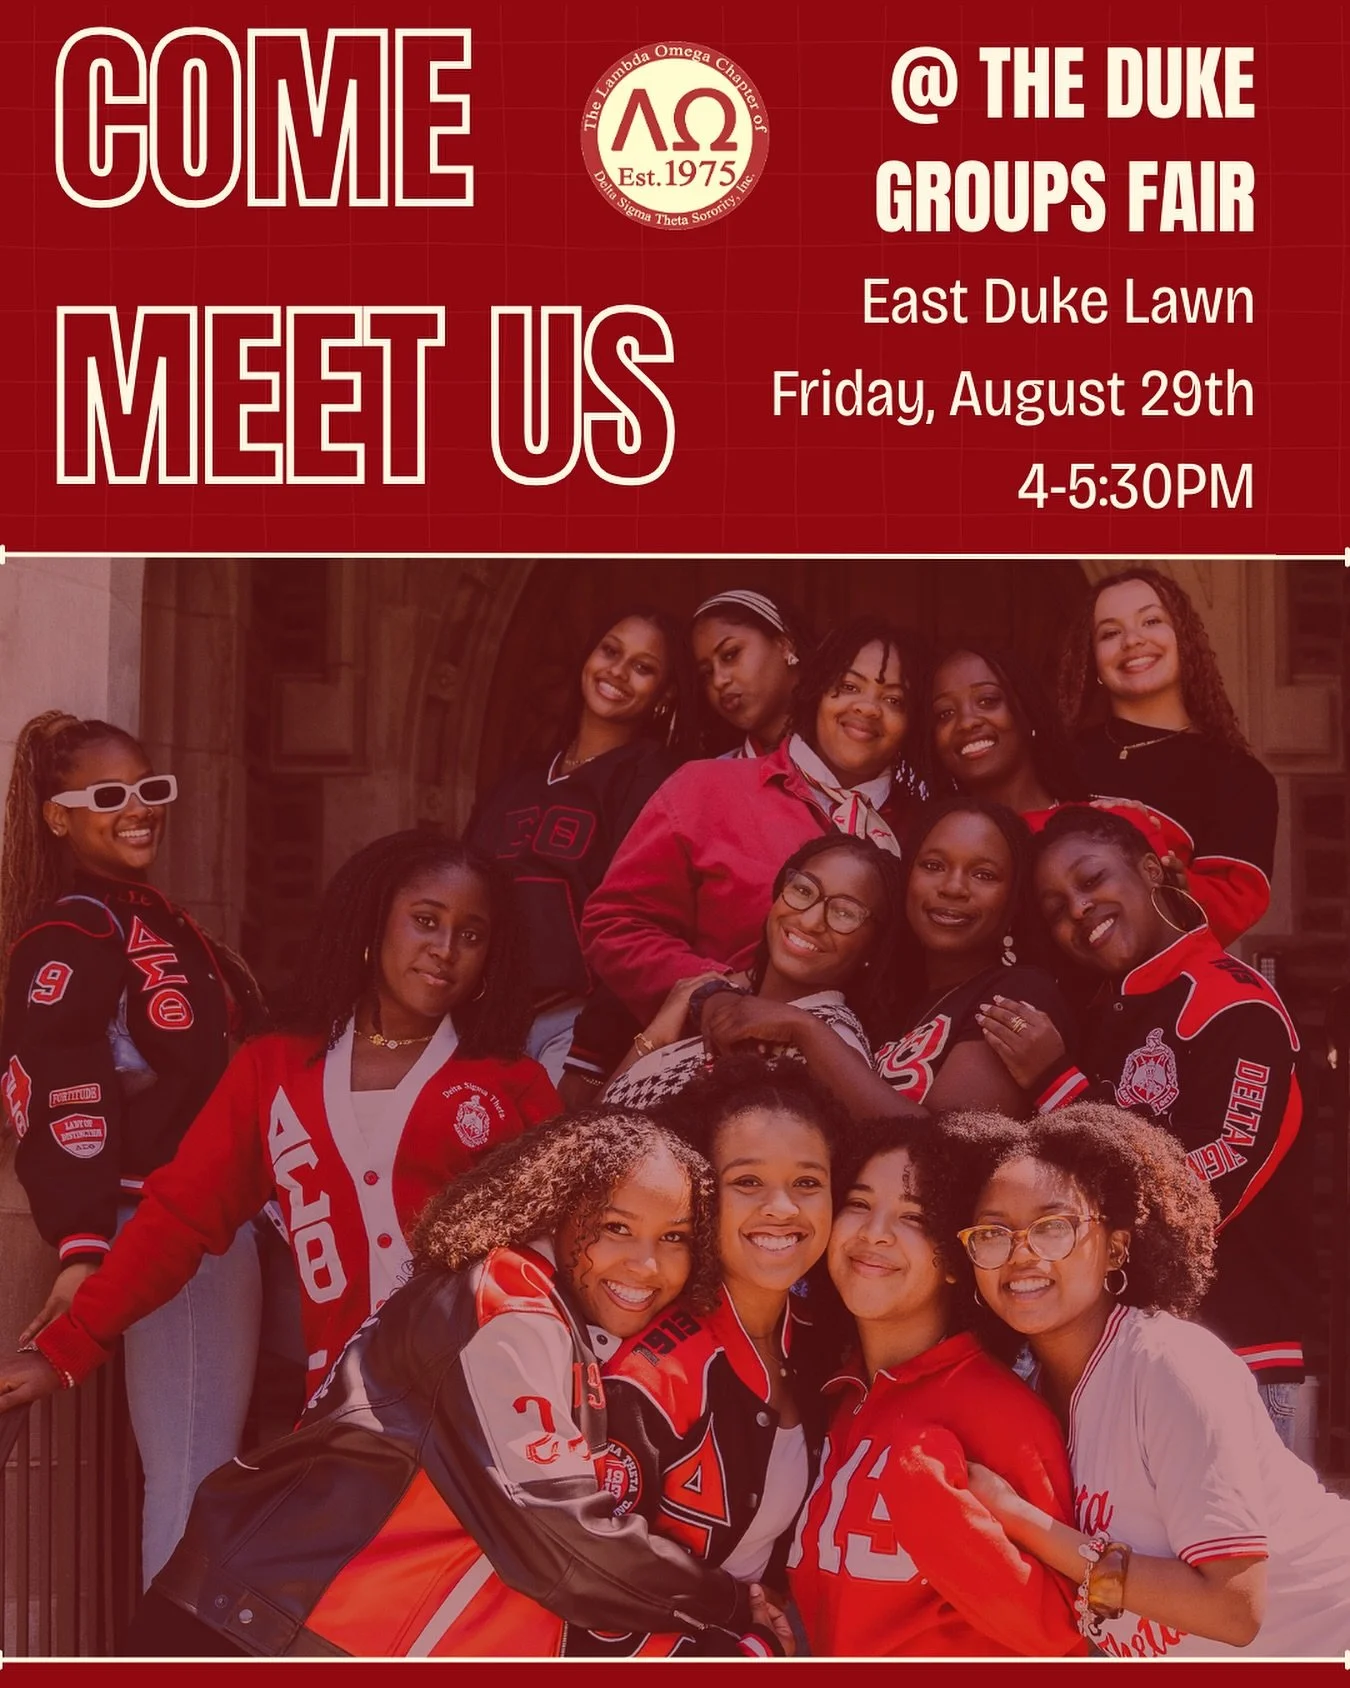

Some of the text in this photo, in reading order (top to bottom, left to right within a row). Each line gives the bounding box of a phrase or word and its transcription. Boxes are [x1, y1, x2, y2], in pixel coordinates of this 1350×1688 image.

[32, 961, 73, 1005] 9
[128, 915, 194, 1029] ΔΣΘ
[52, 1087, 97, 1104] FORTITUDE
[442, 1082, 505, 1120] Delta Sigma Theta
[1221, 1057, 1271, 1147] DELTA
[267, 1085, 348, 1304] ΔΣΘ
[632, 1310, 702, 1367] 1913
[623, 1455, 639, 1494] THETA
